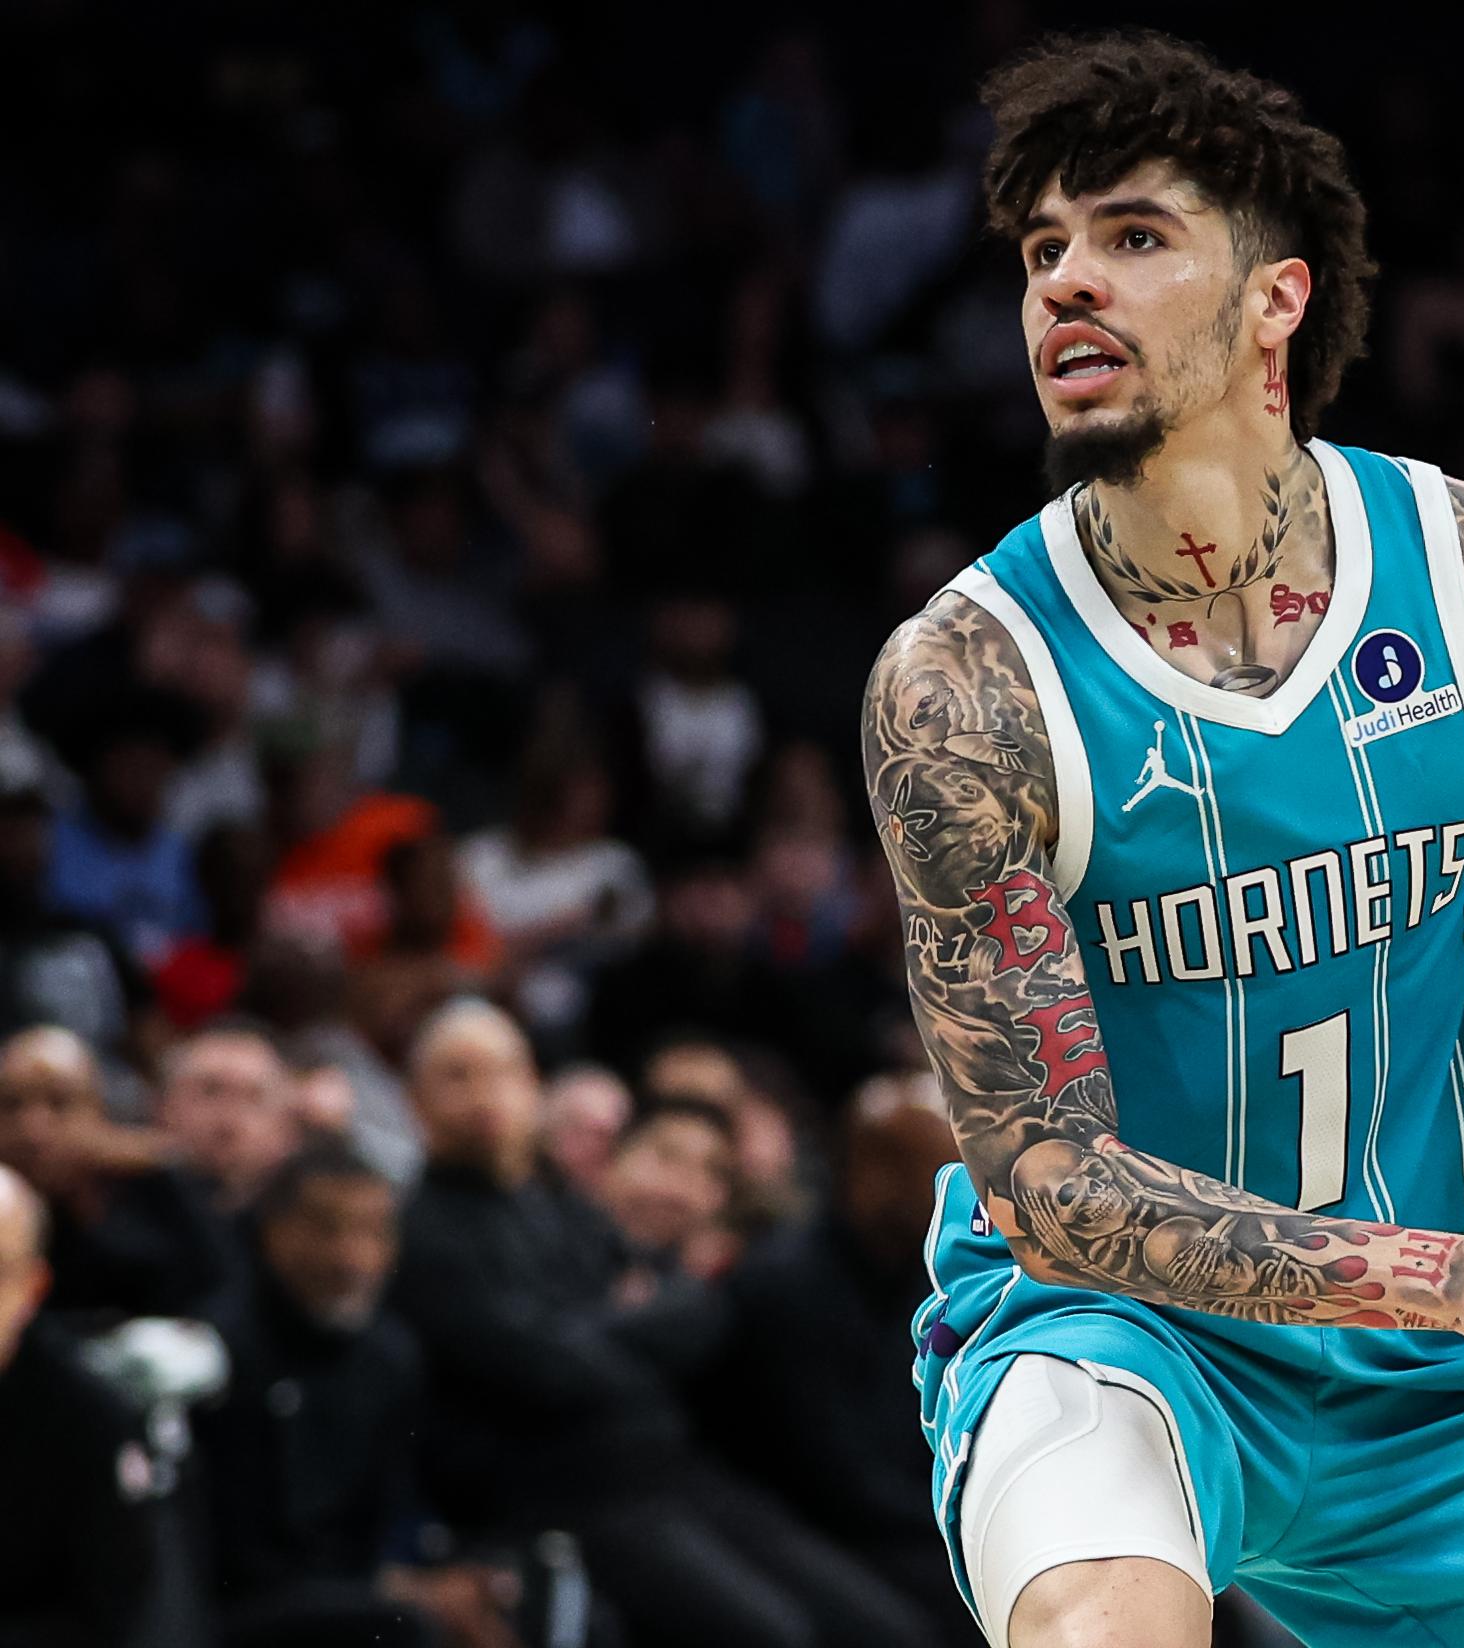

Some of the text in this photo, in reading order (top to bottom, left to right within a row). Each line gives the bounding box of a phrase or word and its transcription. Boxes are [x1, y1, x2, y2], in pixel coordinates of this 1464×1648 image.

[1353, 689, 1459, 741] Judi Health
[1278, 1008, 1352, 1214] 1
